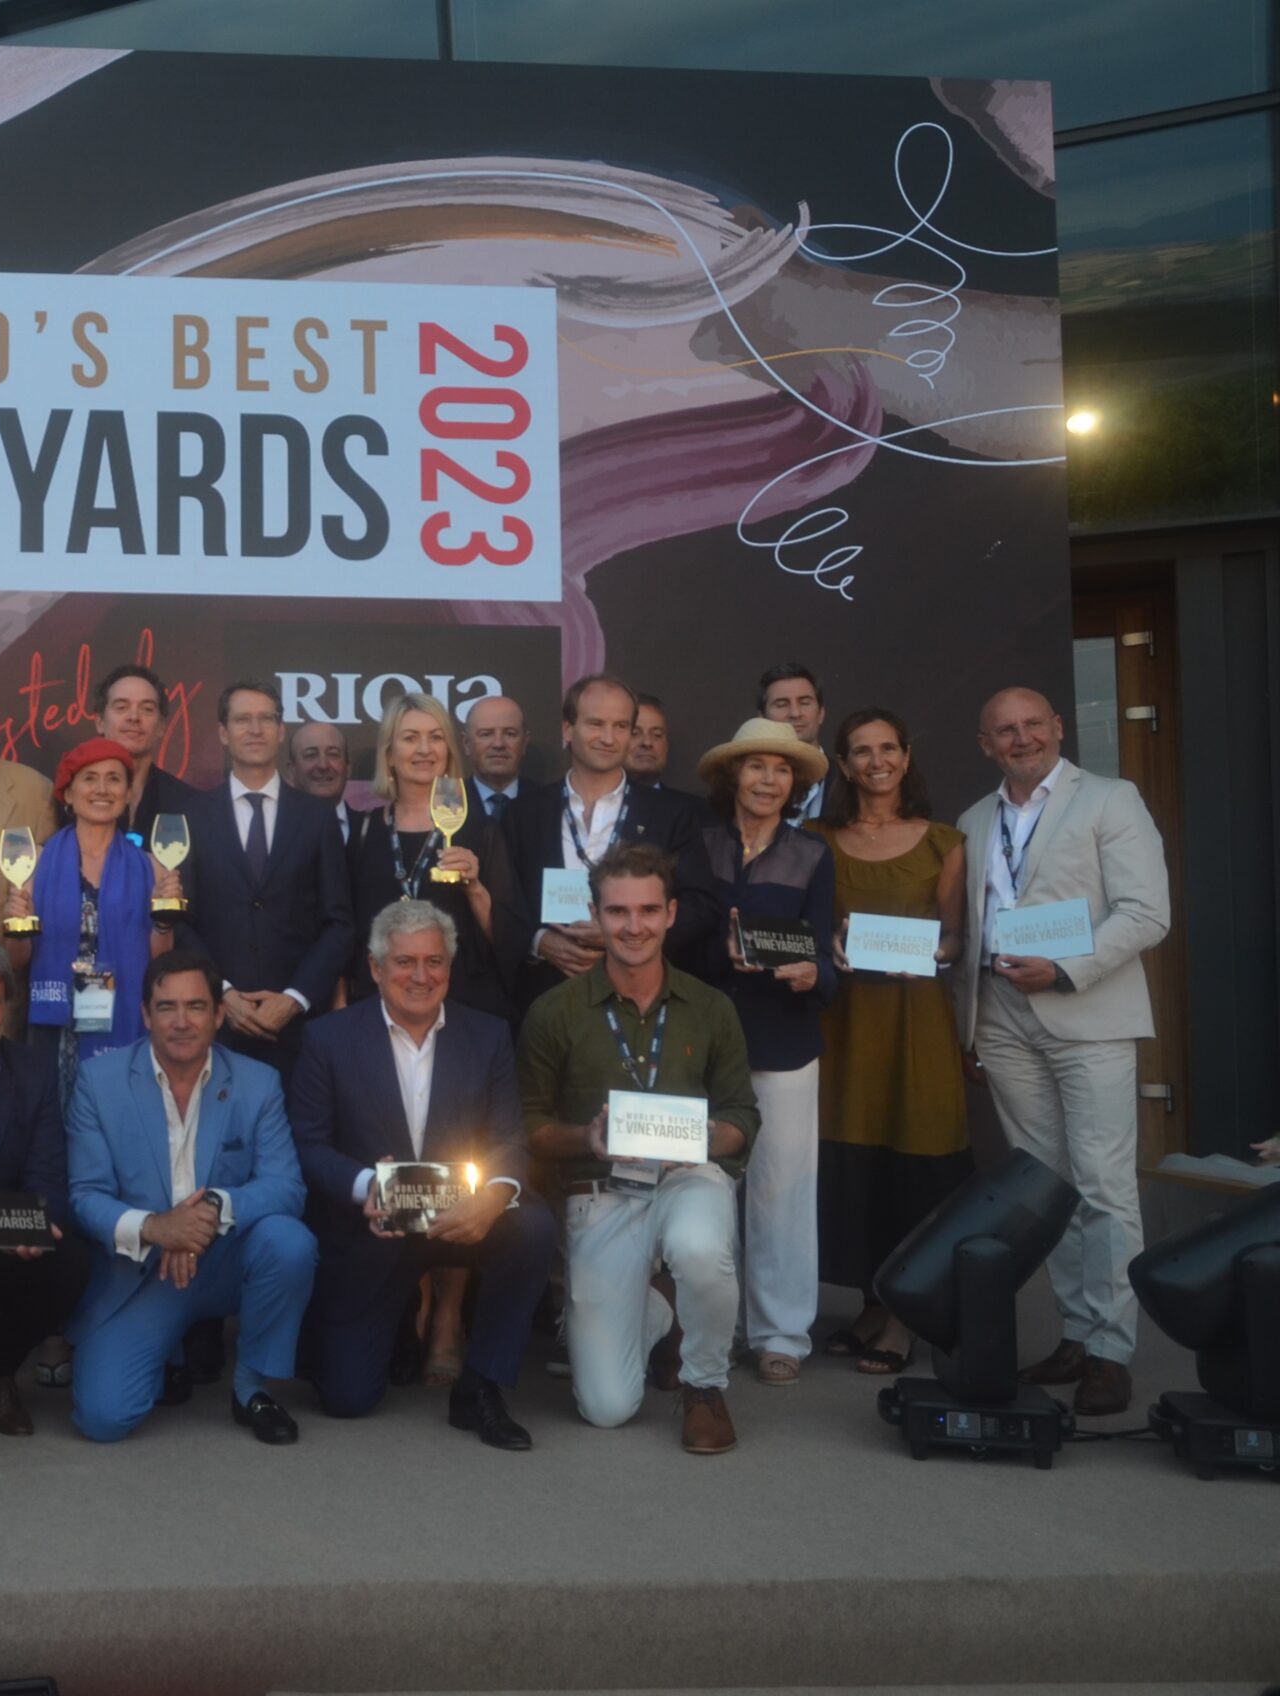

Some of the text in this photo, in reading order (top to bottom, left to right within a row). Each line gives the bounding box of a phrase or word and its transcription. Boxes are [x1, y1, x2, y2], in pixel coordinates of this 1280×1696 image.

[173, 314, 388, 396] BEST
[418, 321, 535, 567] 2023
[753, 937, 806, 954] VINEYARDS
[1014, 928, 1074, 945] VINEYARDS
[862, 939, 921, 956] VINEYARDS
[626, 1120, 690, 1140] VINEYARDS
